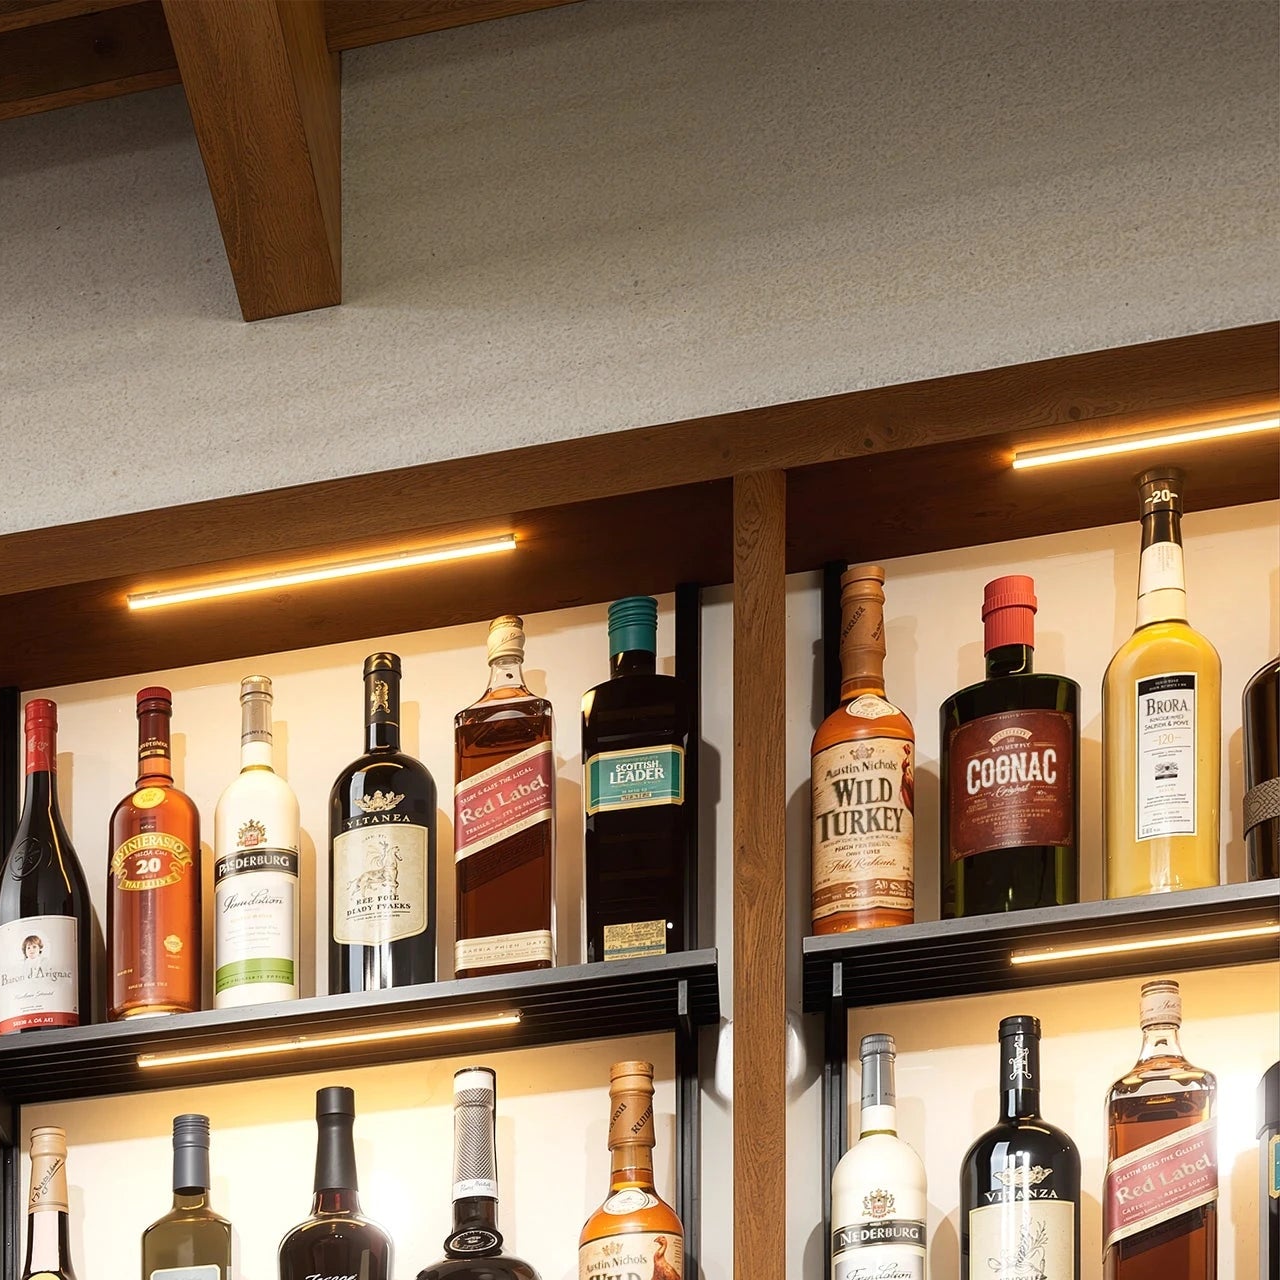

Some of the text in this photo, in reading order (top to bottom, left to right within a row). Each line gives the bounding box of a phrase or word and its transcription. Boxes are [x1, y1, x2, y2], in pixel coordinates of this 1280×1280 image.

[1146, 698, 1188, 717] BRORA
[609, 768, 665, 785] LEADER
[615, 760, 659, 773] SCOTTISH
[967, 749, 1057, 796] COGNAC
[460, 776, 546, 827] Red Label
[832, 777, 892, 807] WILD
[817, 807, 903, 842] TURKEY
[136, 858, 161, 875] 20
[1115, 1153, 1213, 1205] Red Label
[840, 1226, 919, 1244] NEDERBURG
